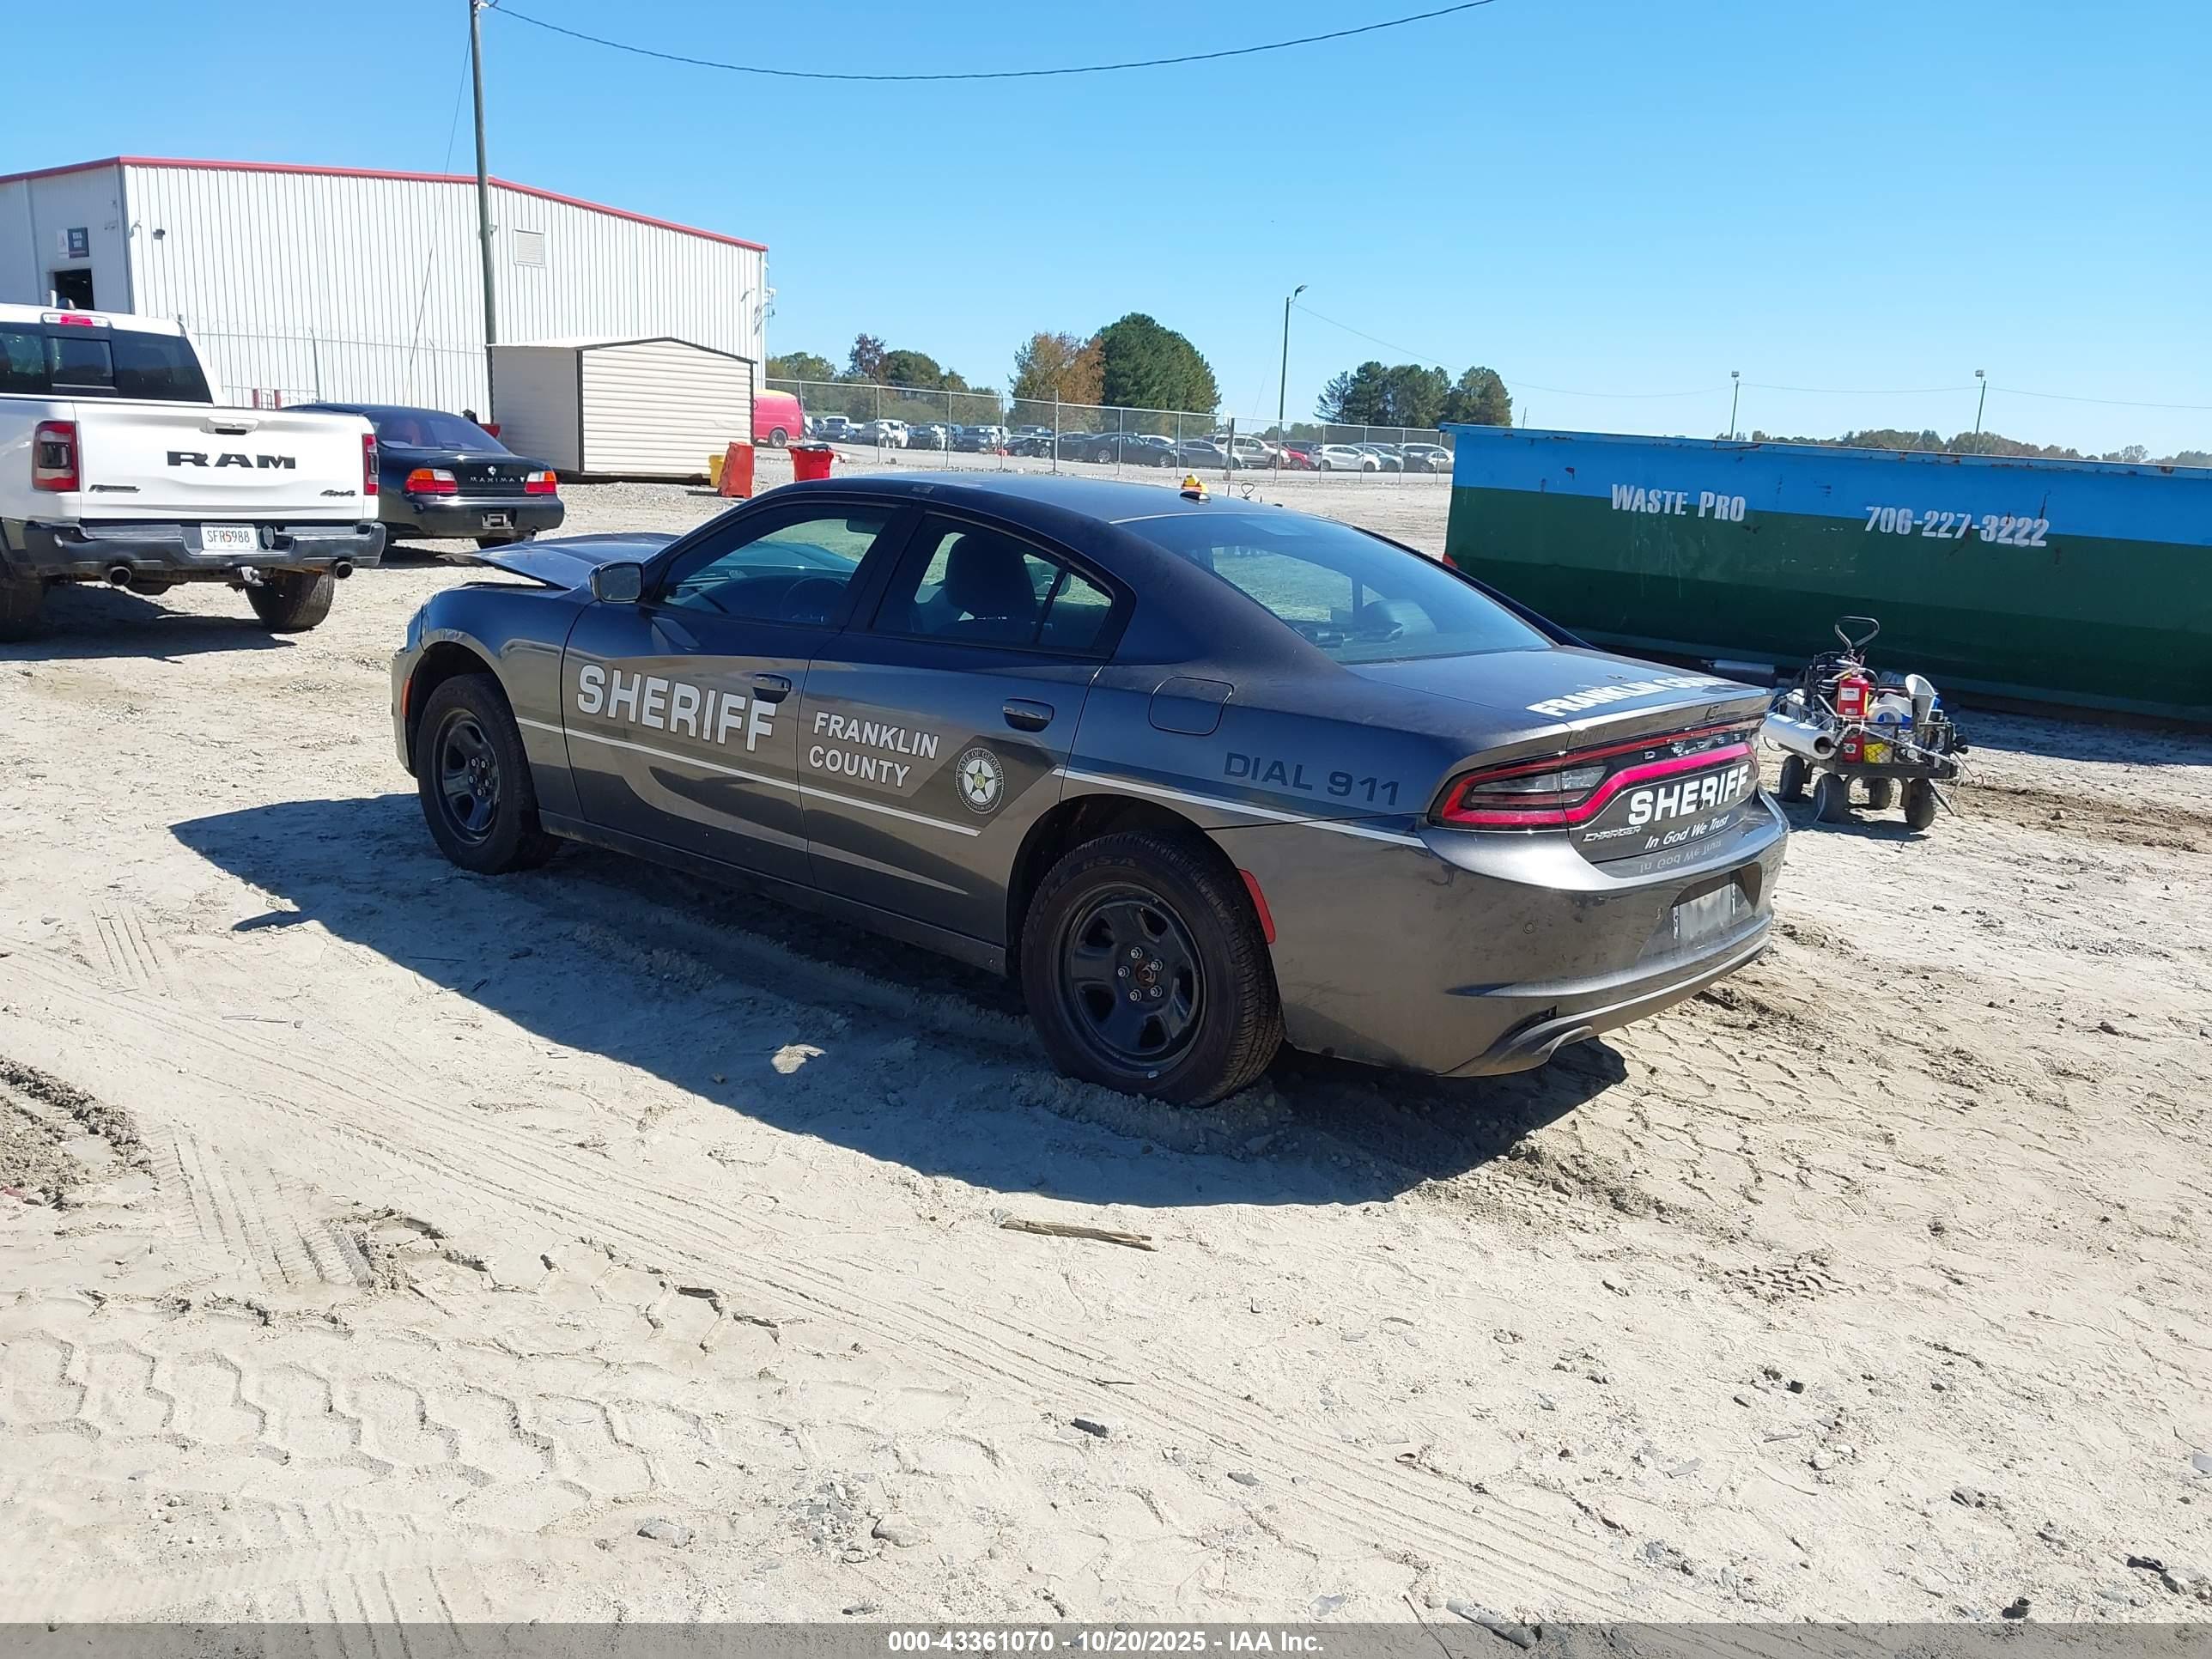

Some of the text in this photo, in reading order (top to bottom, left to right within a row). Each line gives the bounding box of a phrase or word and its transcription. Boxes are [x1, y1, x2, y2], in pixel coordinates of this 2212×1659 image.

[167, 451, 295, 469] RAM
[1611, 483, 1746, 522] WASTE PRO
[207, 530, 250, 543] SFR5988
[1864, 506, 2050, 546] 706-227-3222
[577, 665, 778, 751] SHERIFF
[1525, 680, 1674, 716] FRANKLIN
[813, 711, 939, 759] FRANKLIN
[809, 745, 911, 787] COUNTY
[1224, 752, 1400, 805] DIAL 911
[1628, 764, 1749, 825] SHERIFF
[1583, 825, 1642, 842] CHARGER
[1644, 814, 1729, 849] In God We Trust
